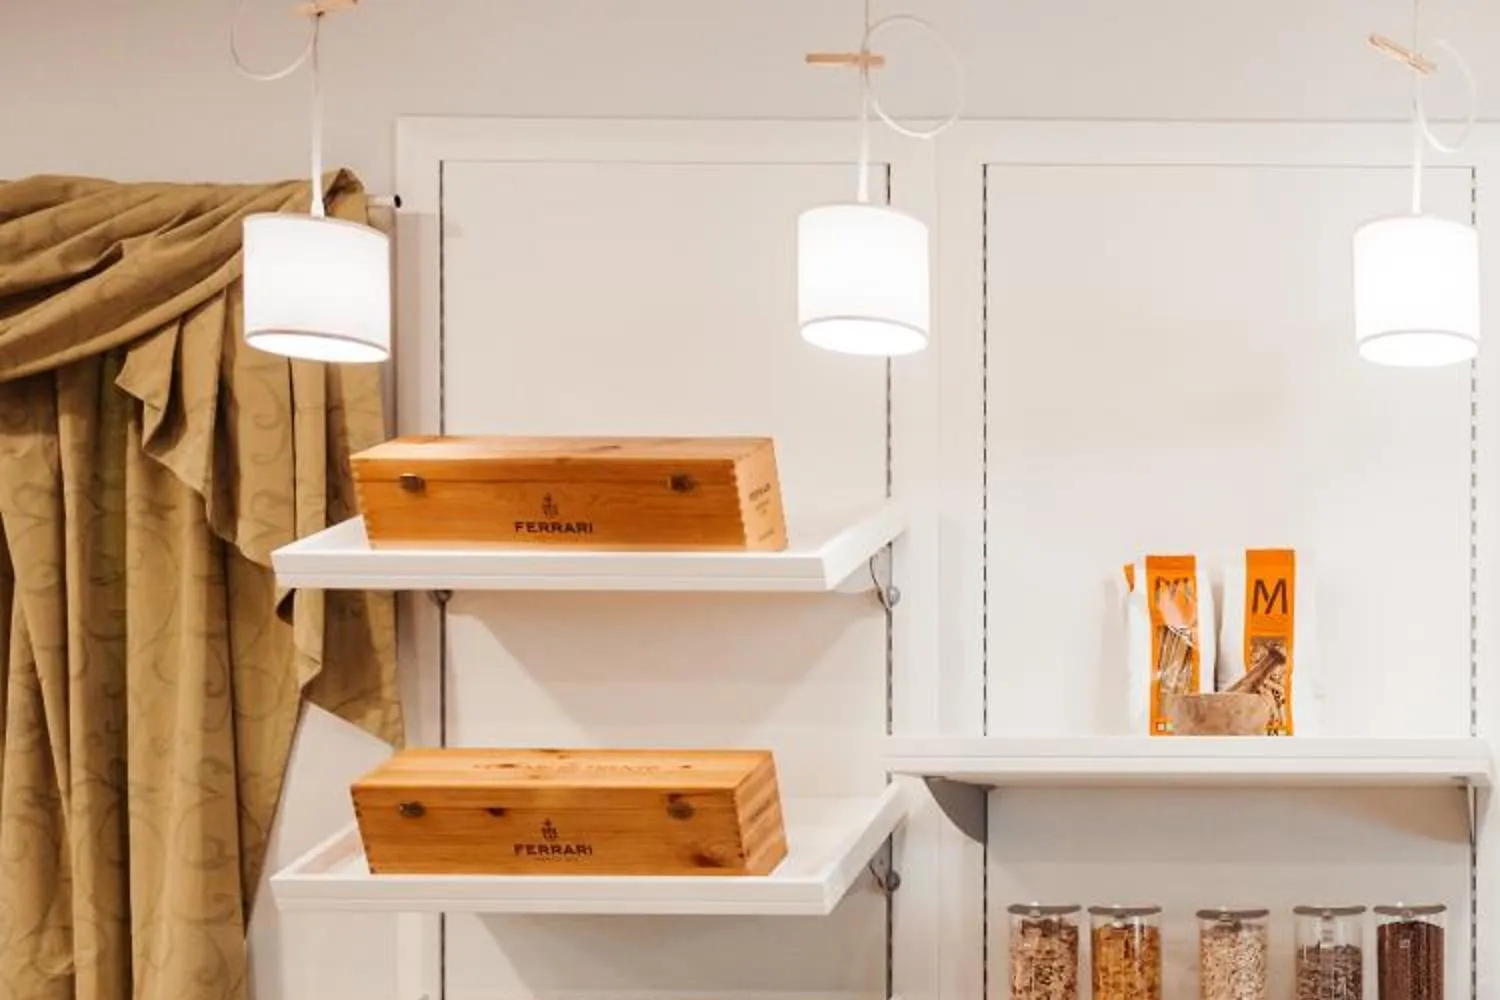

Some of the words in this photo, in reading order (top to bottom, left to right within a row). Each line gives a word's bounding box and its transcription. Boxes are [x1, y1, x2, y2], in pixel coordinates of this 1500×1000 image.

[514, 521, 593, 534] FERRARI
[1252, 578, 1288, 615] M
[513, 844, 593, 856] FERRARI
